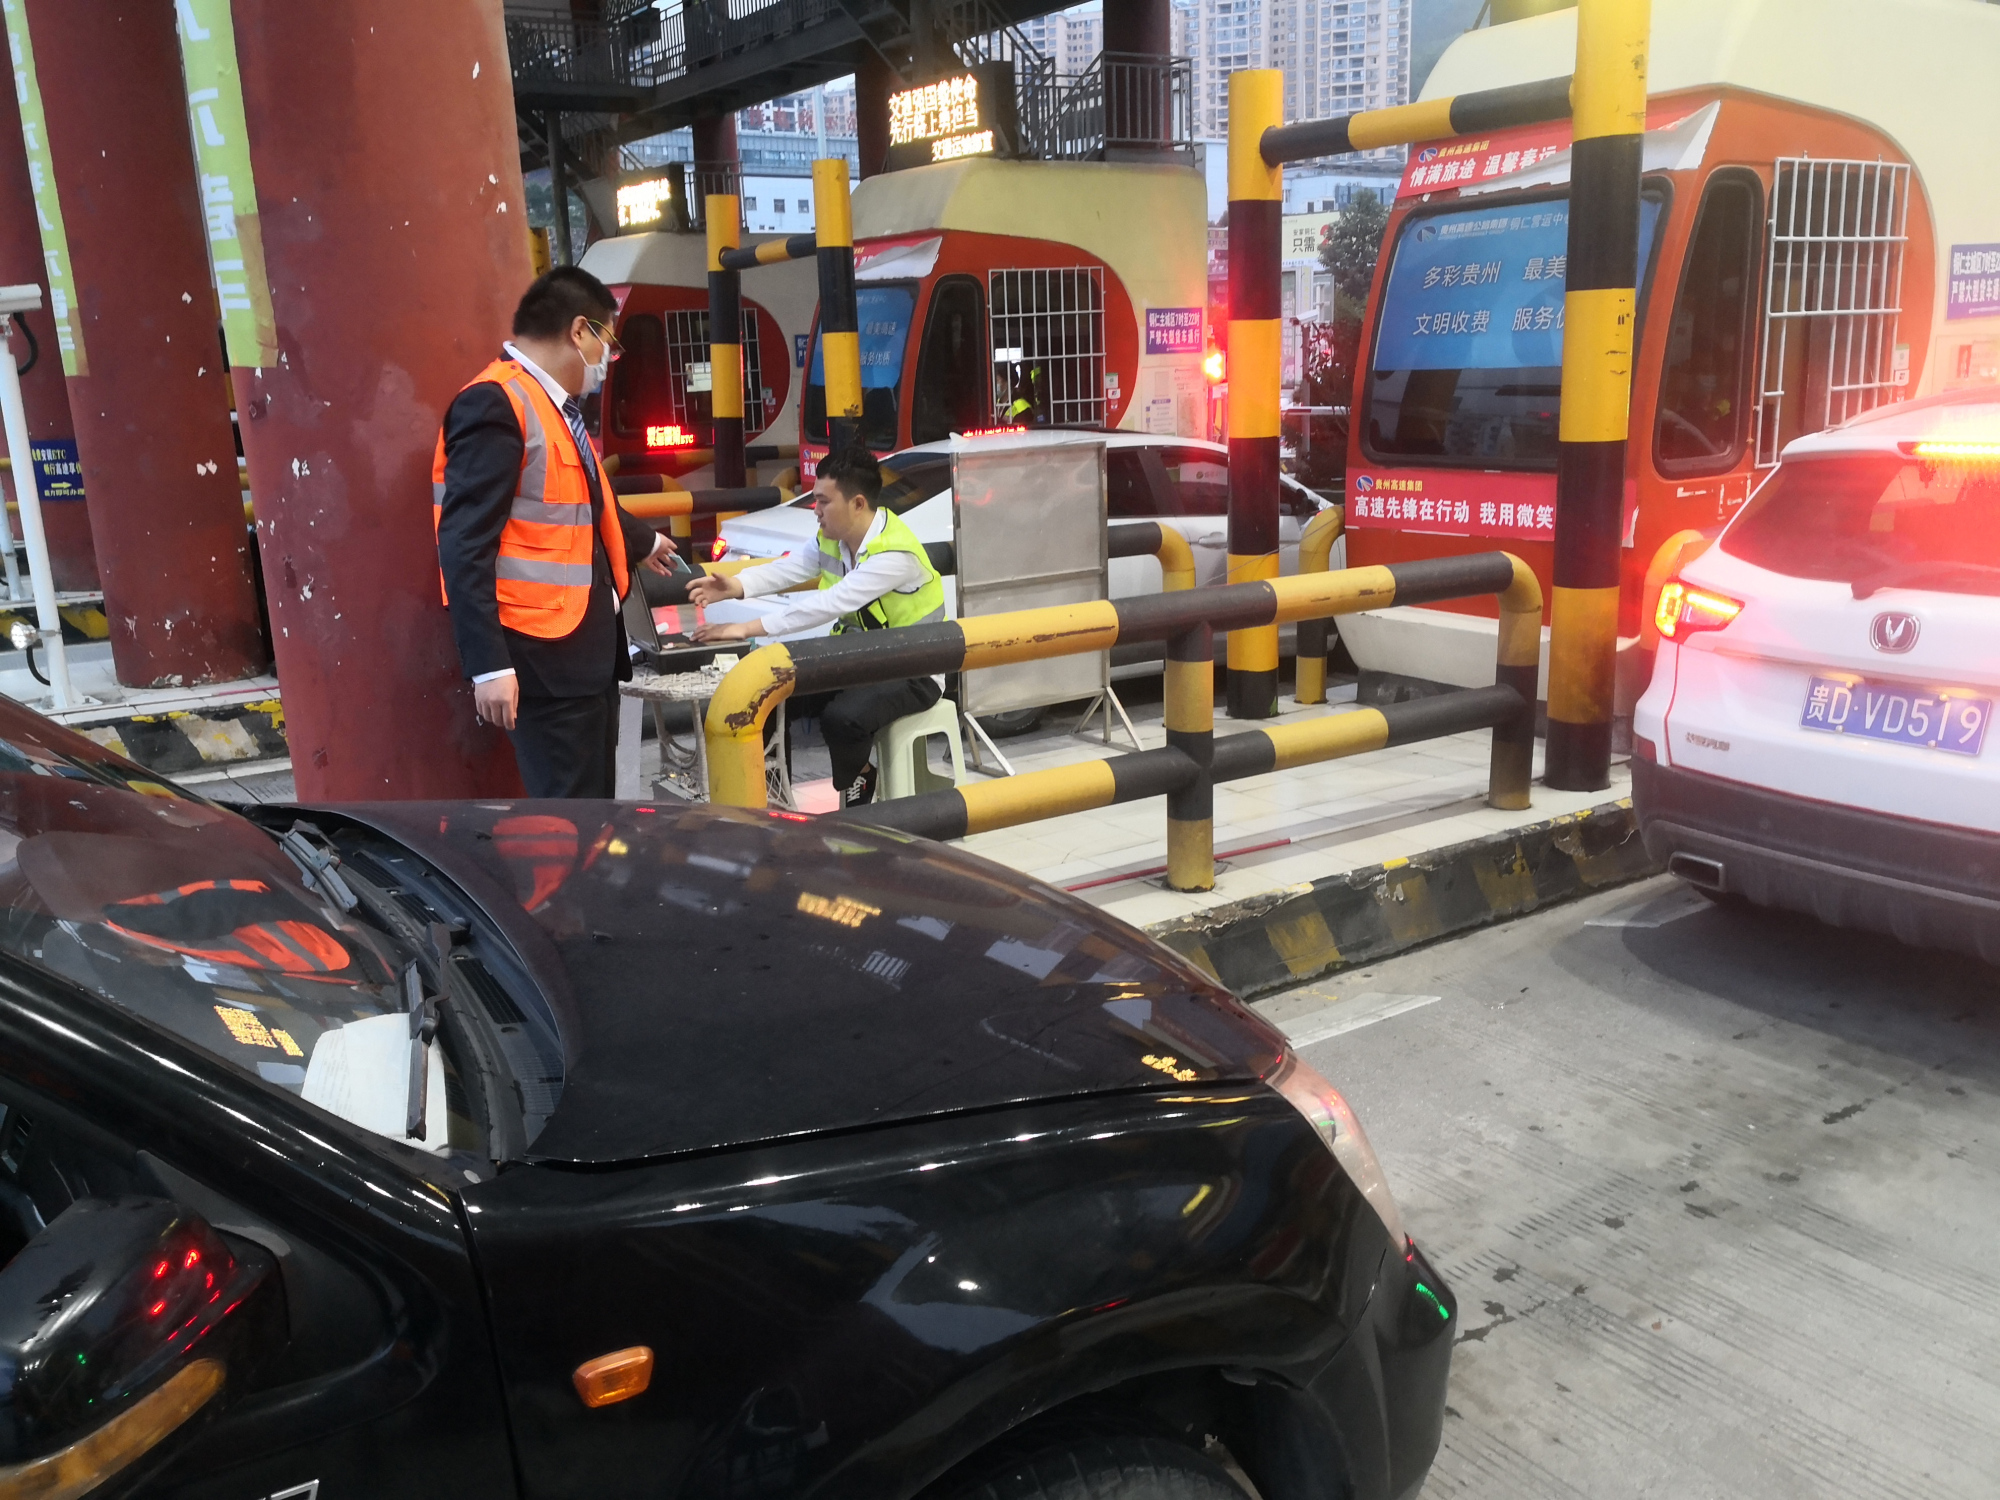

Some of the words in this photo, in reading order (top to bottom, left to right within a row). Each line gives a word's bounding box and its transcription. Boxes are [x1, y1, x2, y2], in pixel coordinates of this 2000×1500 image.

[1437, 140, 1490, 158] 贵州高速集团
[1409, 157, 1477, 188] 情满旅途
[1440, 217, 1509, 235] 贵州高速公路集团
[1292, 236, 1316, 253] 只需
[1423, 261, 1502, 290] 多彩贵州
[1522, 254, 1567, 281] 最美
[1413, 310, 1490, 336] 文明收费
[1148, 328, 1200, 346] 严禁大型货车通行
[1375, 478, 1423, 492] 贵州高速集团
[1354, 494, 1470, 524] 高速先锋在行动
[1479, 500, 1554, 530] 我用微笑
